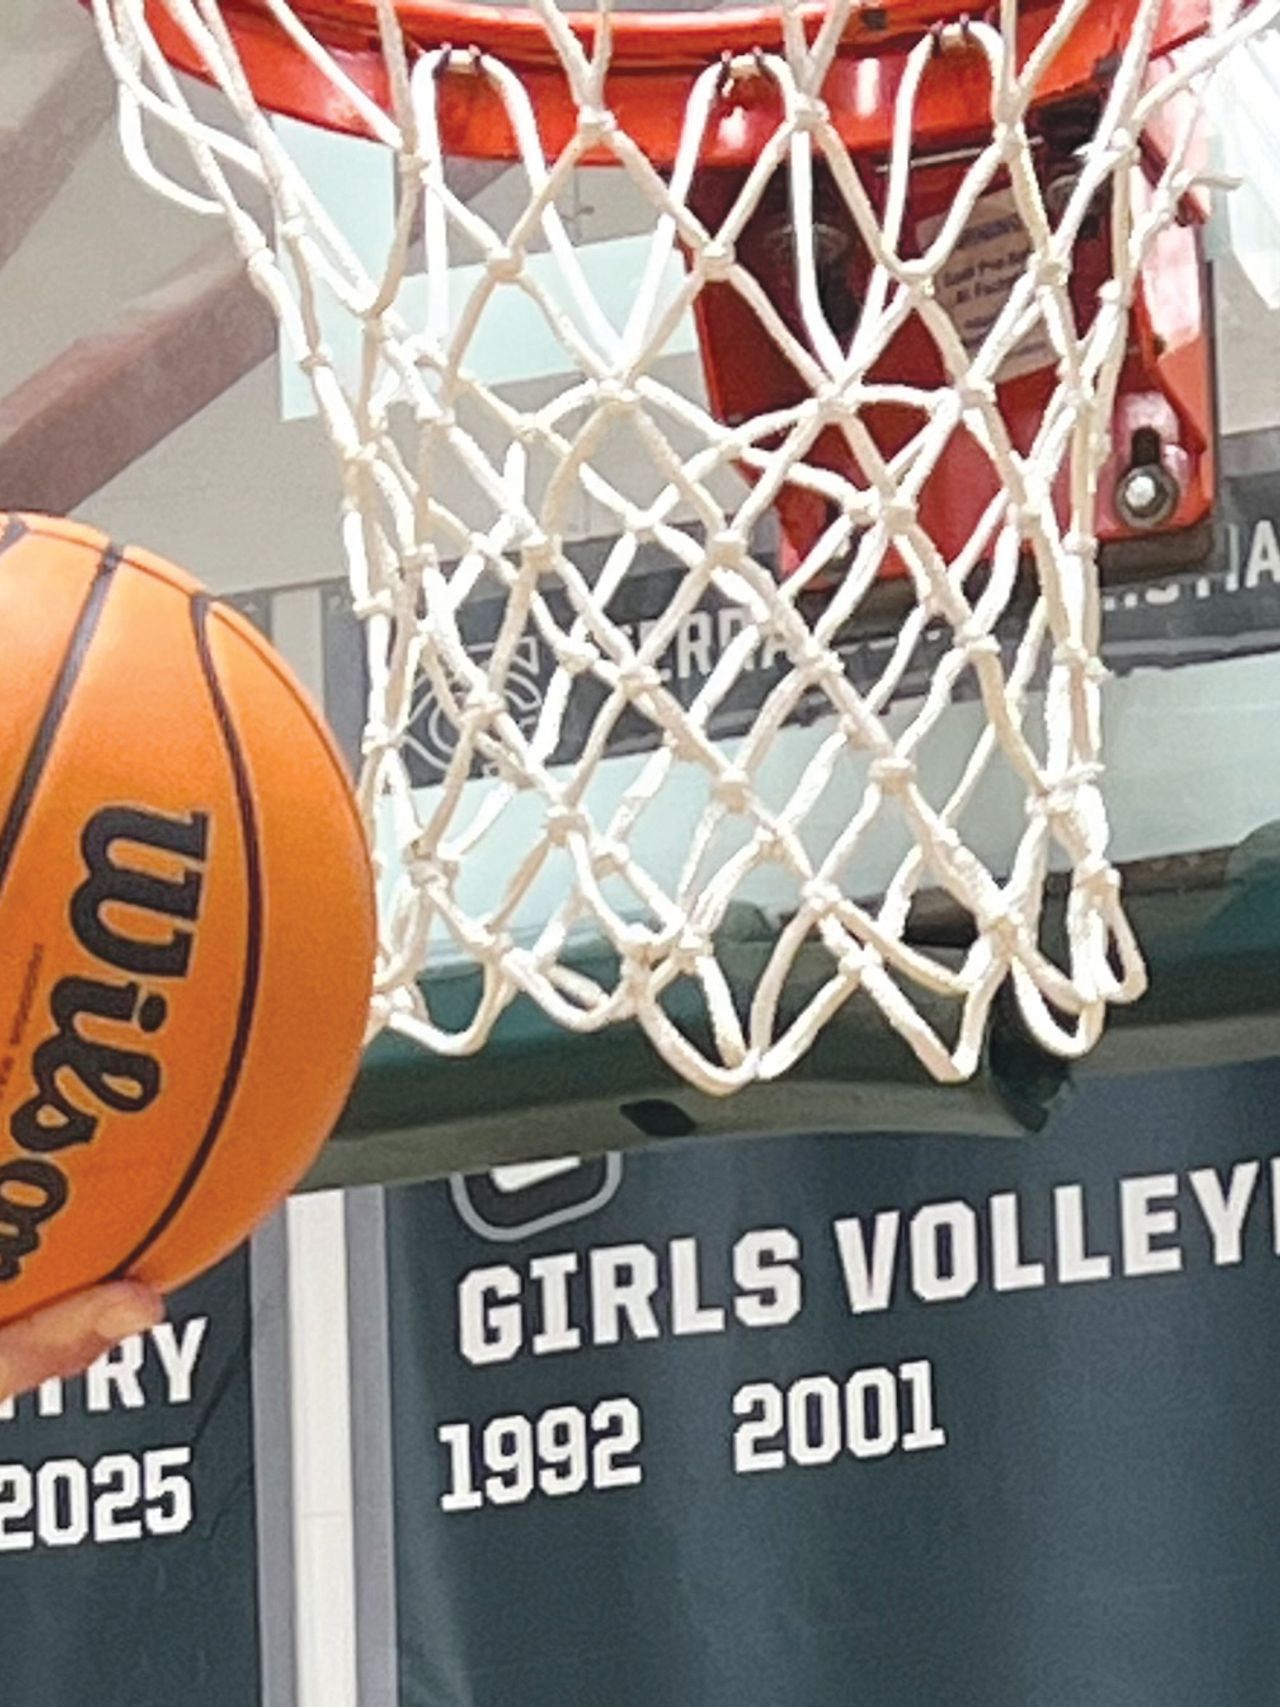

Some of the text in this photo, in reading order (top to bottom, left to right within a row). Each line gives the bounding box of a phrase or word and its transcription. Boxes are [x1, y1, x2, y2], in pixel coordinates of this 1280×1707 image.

[456, 1228, 803, 1367] GIRLS
[437, 1360, 947, 1512] 1992 2001
